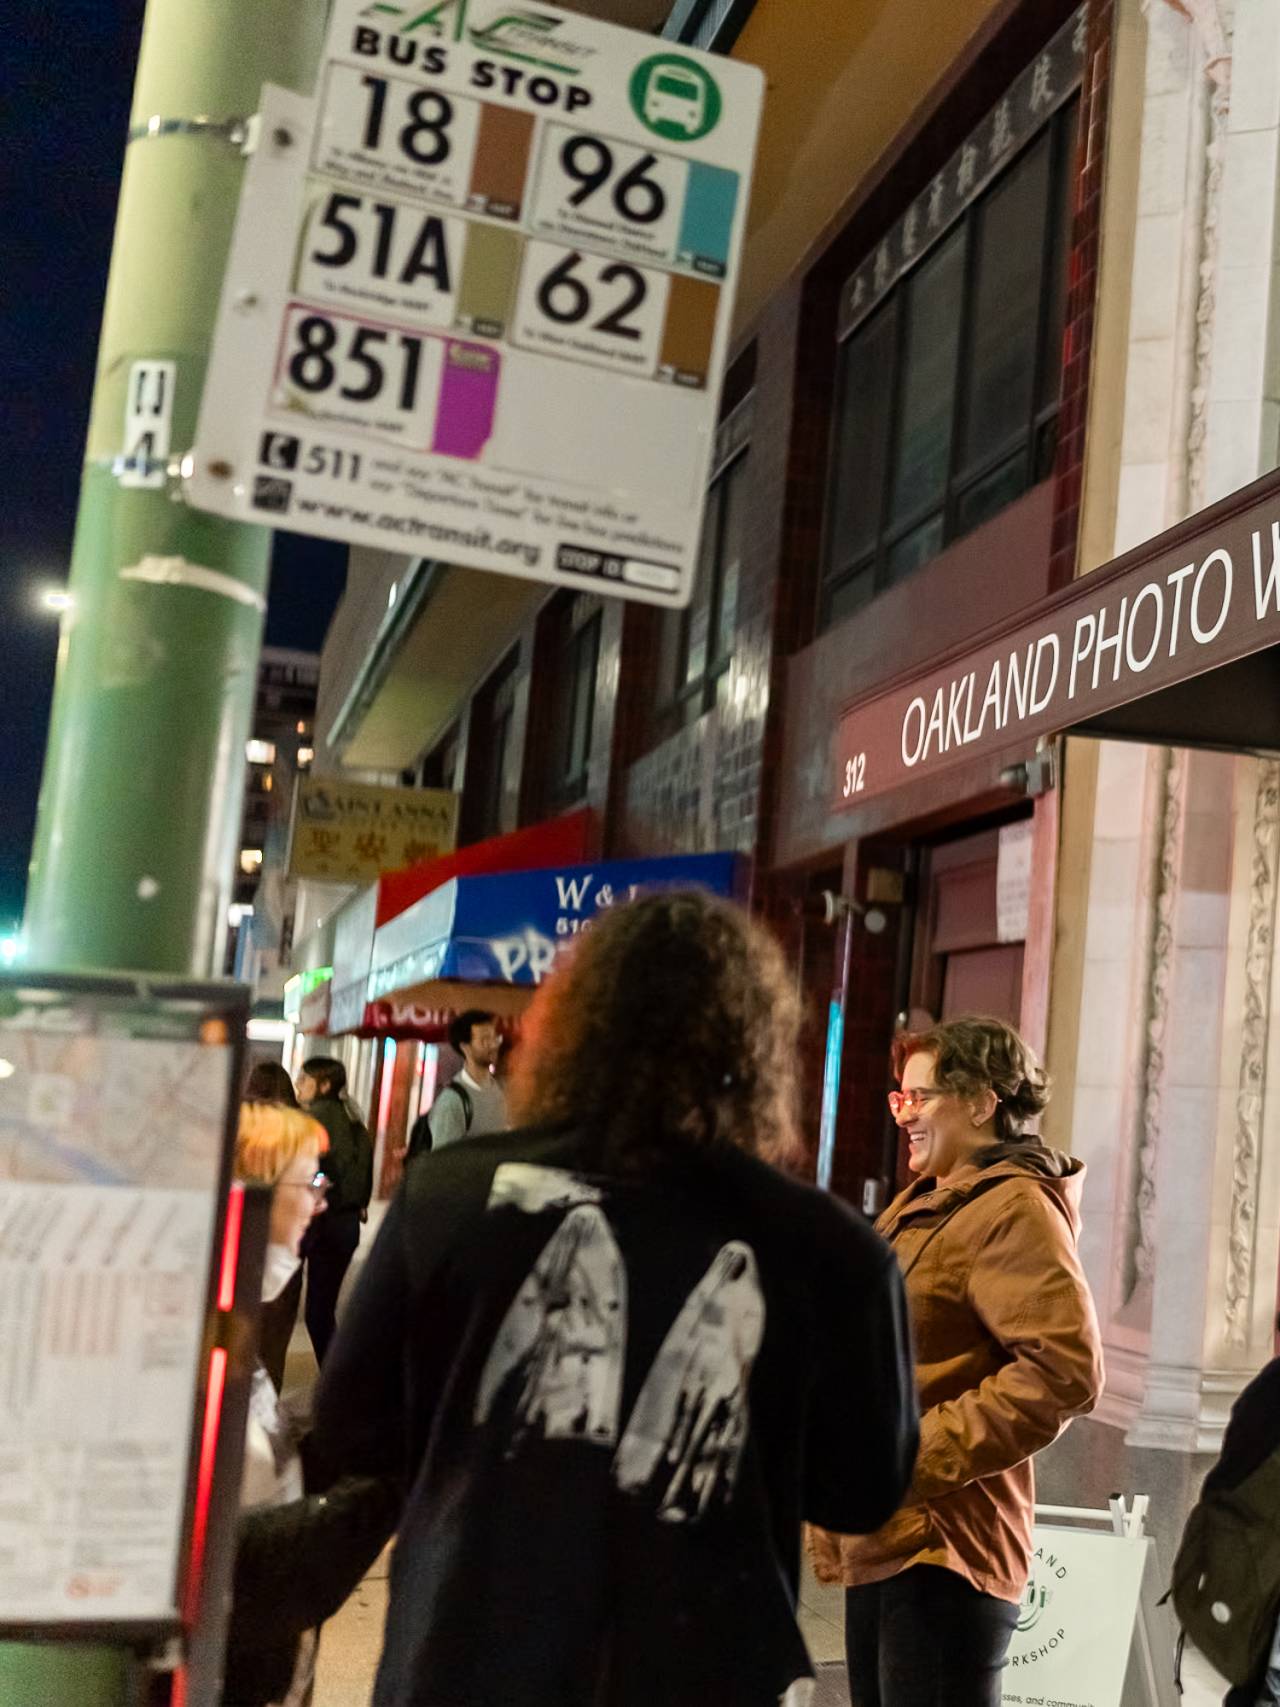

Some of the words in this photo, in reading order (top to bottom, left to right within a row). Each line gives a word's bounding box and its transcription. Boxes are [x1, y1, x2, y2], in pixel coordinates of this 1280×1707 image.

[352, 24, 448, 75] BUS
[470, 59, 593, 114] STOP
[362, 74, 453, 165] 18
[561, 135, 666, 224] 96
[312, 193, 452, 293] 51A
[537, 251, 647, 341] 62
[289, 316, 423, 412] 851
[303, 445, 362, 482] 511
[902, 634, 1060, 766] OAKLAND
[1069, 549, 1233, 688] PHOTO
[843, 752, 867, 798] 312
[555, 873, 594, 912] W
[595, 883, 614, 908] &
[490, 925, 572, 985] PR
[1011, 1627, 1067, 1668] RKSHOP
[1026, 1696, 1044, 1706] and
